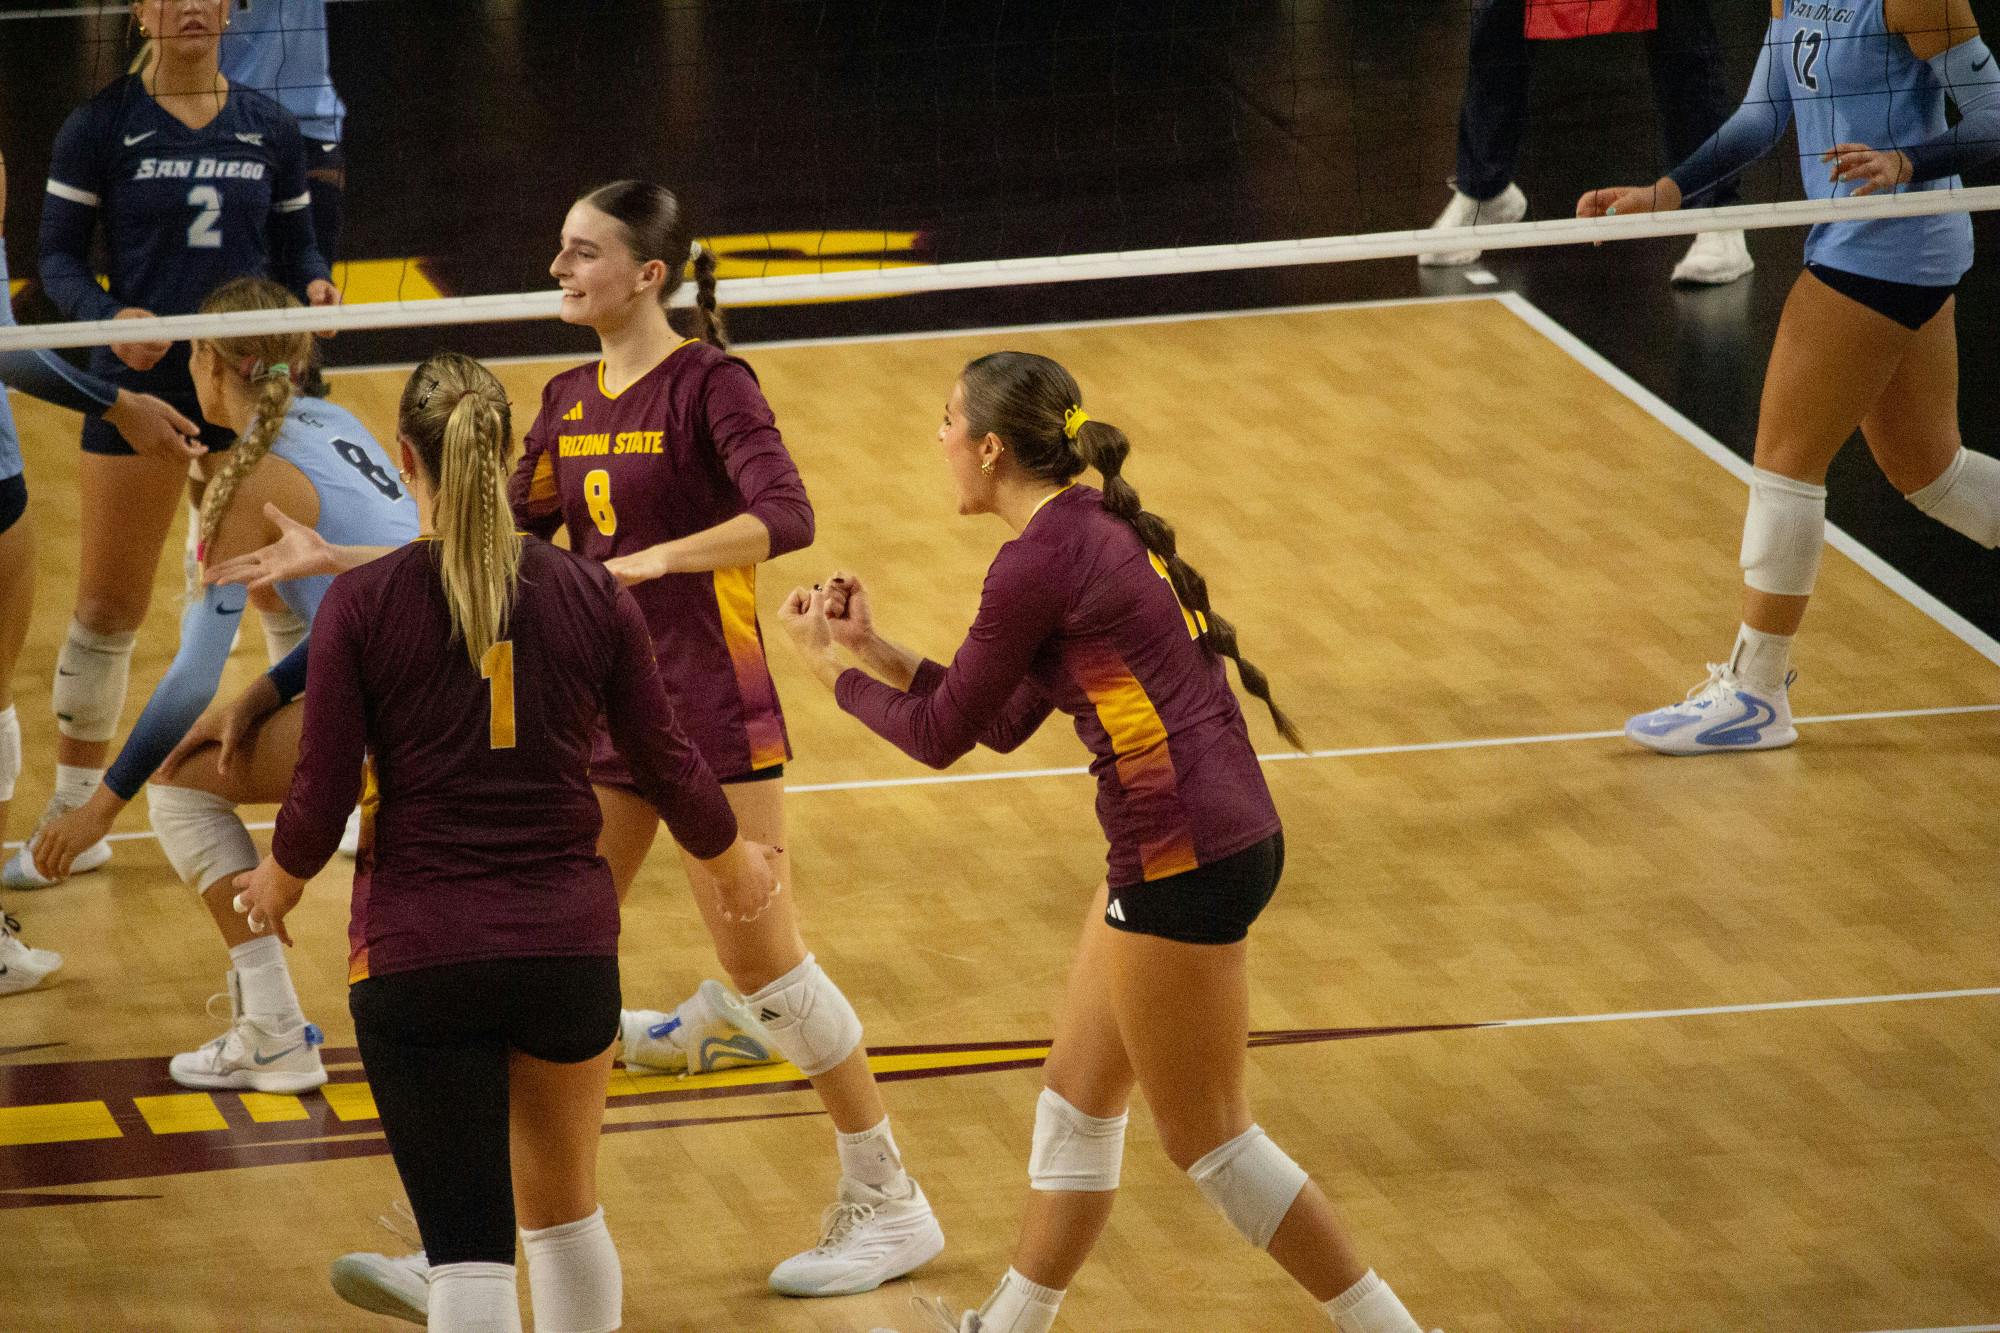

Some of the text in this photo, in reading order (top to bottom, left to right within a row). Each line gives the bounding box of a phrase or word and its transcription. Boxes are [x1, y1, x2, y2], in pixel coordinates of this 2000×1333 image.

[1792, 27, 1822, 91] 12
[133, 158, 265, 180] SAN DIEGO
[187, 186, 221, 247] 2
[329, 437, 403, 504] 8
[613, 431, 664, 454] STATE
[584, 469, 617, 536] 8
[480, 640, 516, 749] 1
